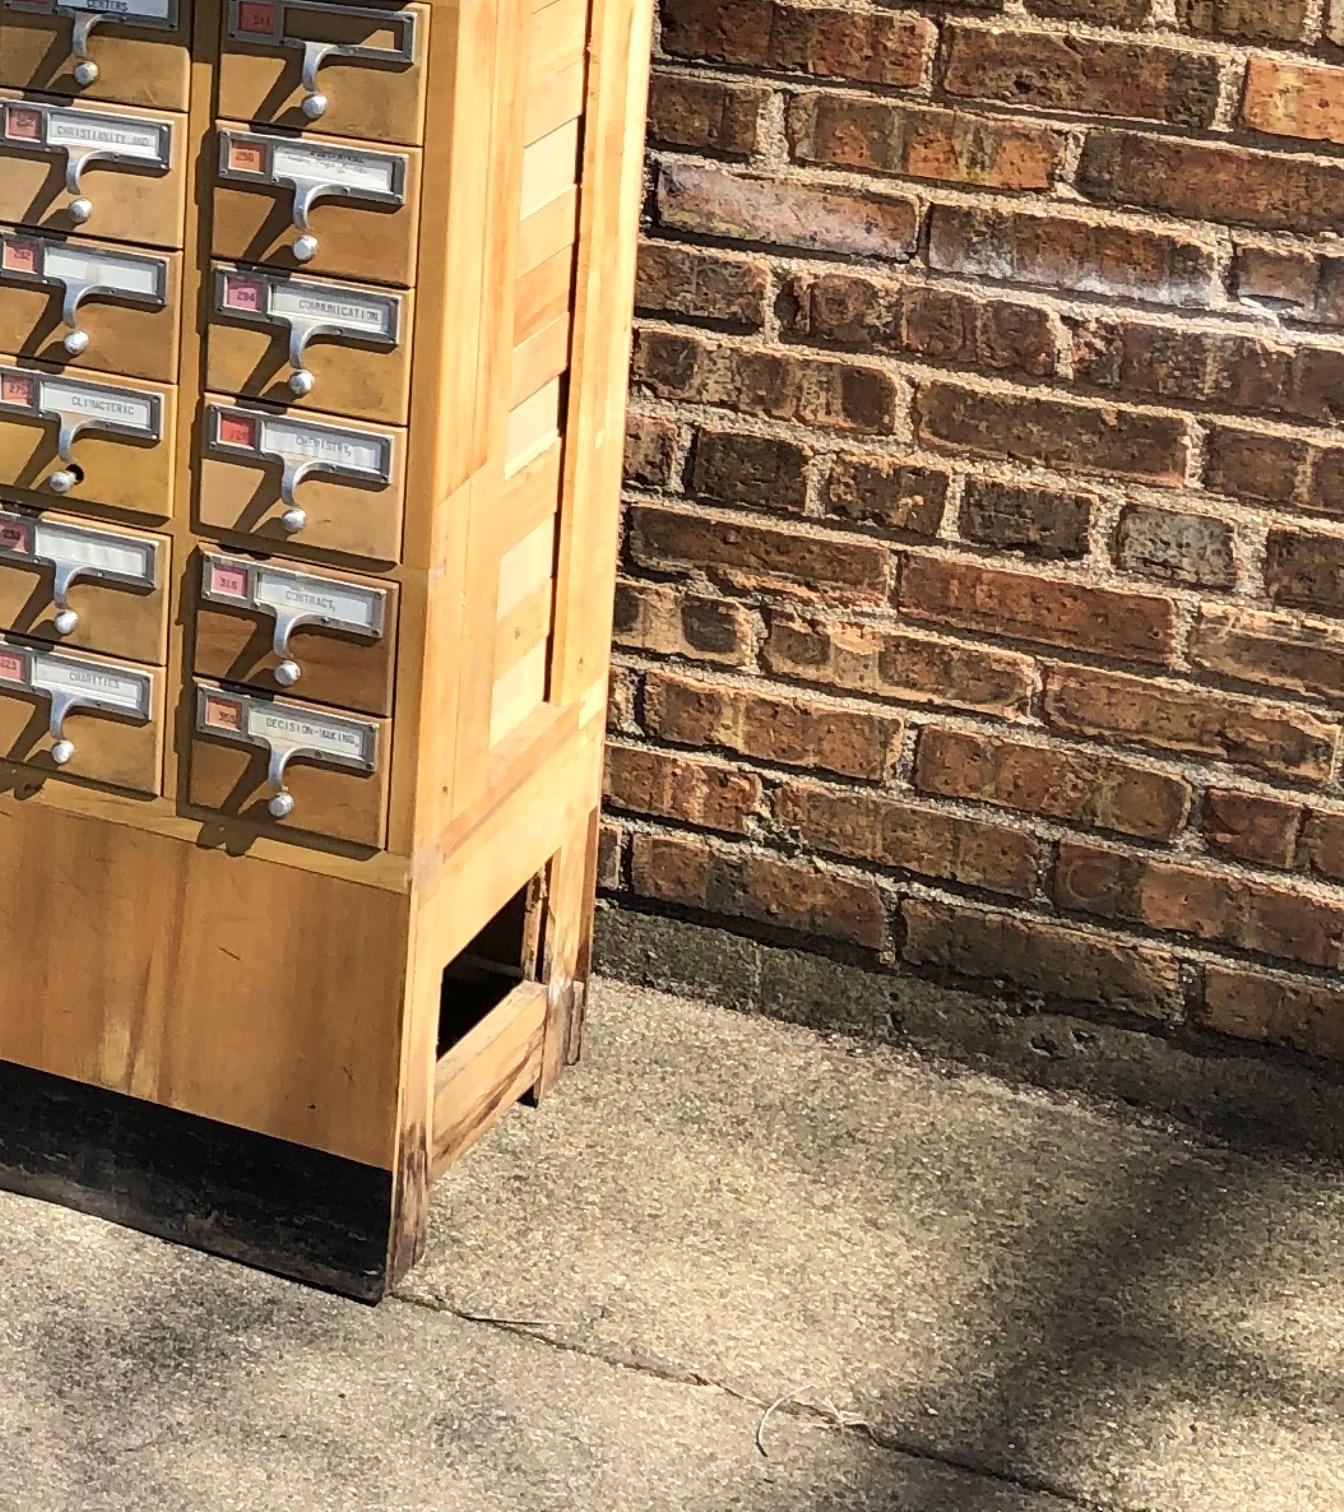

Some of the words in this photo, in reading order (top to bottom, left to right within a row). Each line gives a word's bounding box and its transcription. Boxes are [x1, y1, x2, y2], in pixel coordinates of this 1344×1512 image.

[57, 125, 126, 144] CHRISTIANITY
[237, 291, 255, 301] 294
[299, 299, 379, 321] COMMUNICATION
[72, 395, 134, 415] CLIMACTERIC
[285, 591, 335, 611] CONTRACT,
[70, 671, 120, 689] CHARITIES
[266, 717, 359, 748] DECISION-MAKING,
